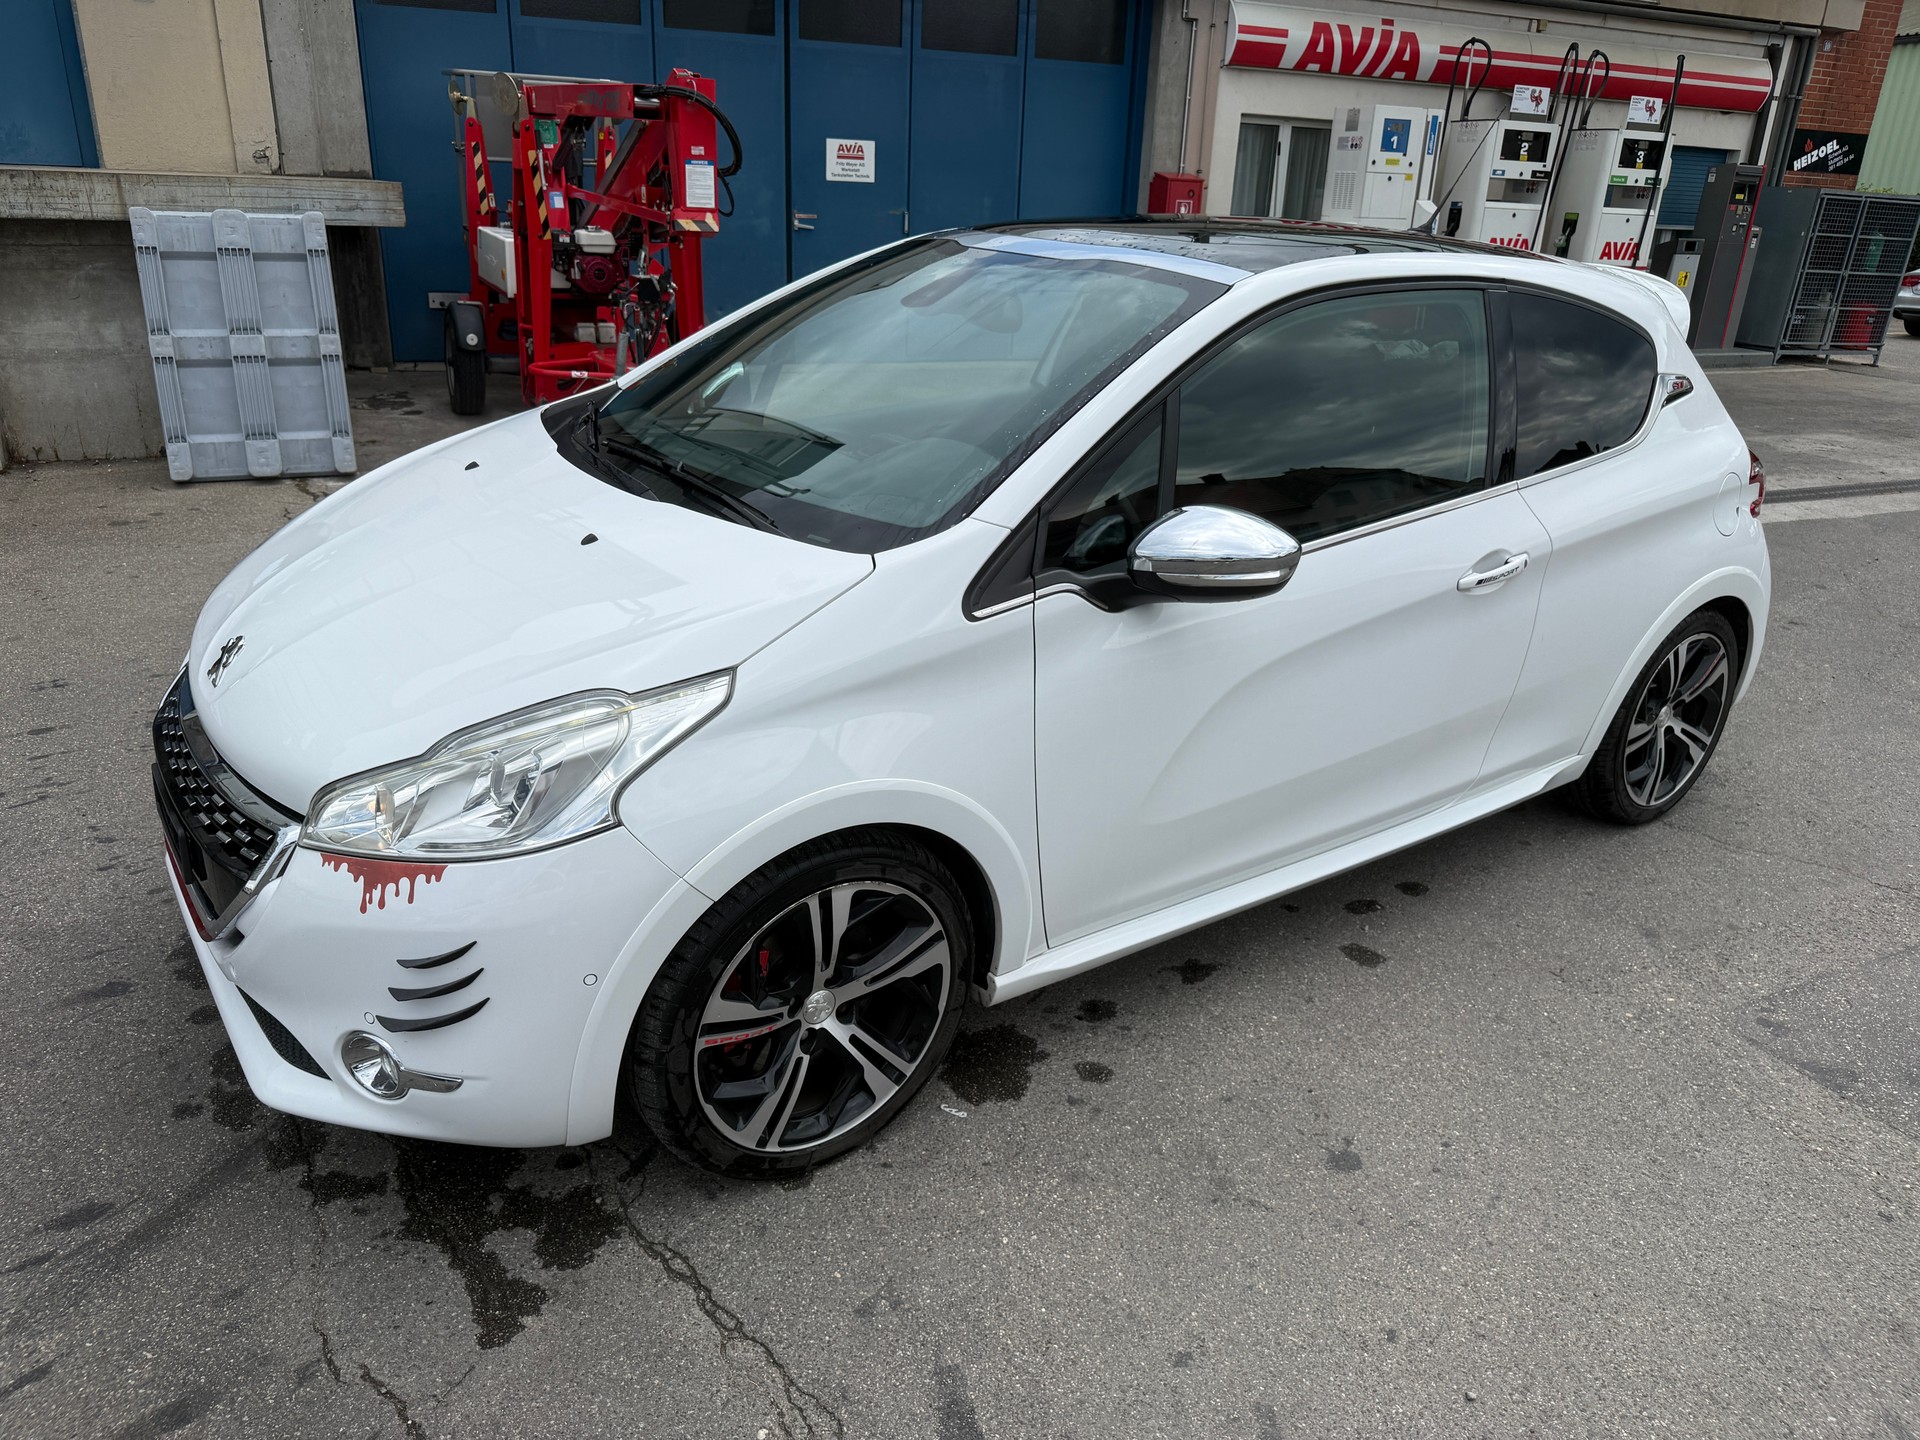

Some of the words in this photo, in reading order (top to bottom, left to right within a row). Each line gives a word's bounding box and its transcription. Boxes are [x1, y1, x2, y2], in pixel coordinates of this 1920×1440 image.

[1293, 18, 1421, 81] AVIA
[837, 142, 865, 154] AVIA
[1391, 136, 1398, 149] 1
[1520, 142, 1529, 155] 2
[1636, 151, 1645, 163] 3
[1793, 139, 1840, 171] HEIZOEL
[704, 1023, 778, 1045] SPORT
